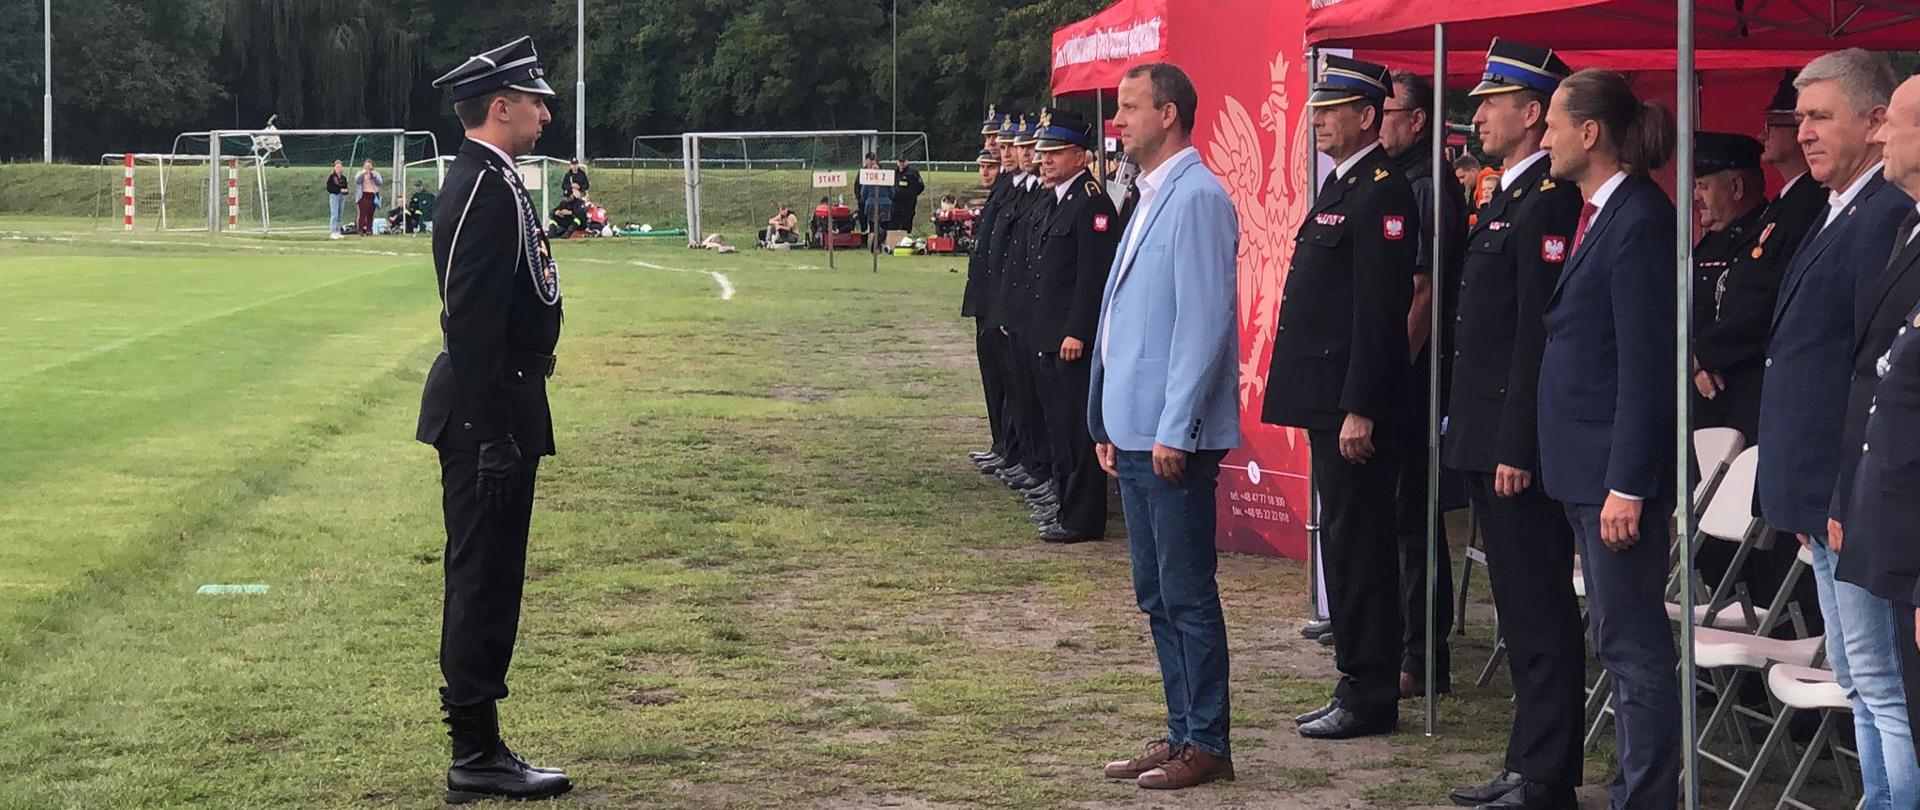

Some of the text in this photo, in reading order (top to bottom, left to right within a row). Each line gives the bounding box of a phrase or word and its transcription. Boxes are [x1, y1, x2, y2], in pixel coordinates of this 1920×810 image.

[818, 175, 841, 184] START
[865, 172, 886, 181] TOR 2
